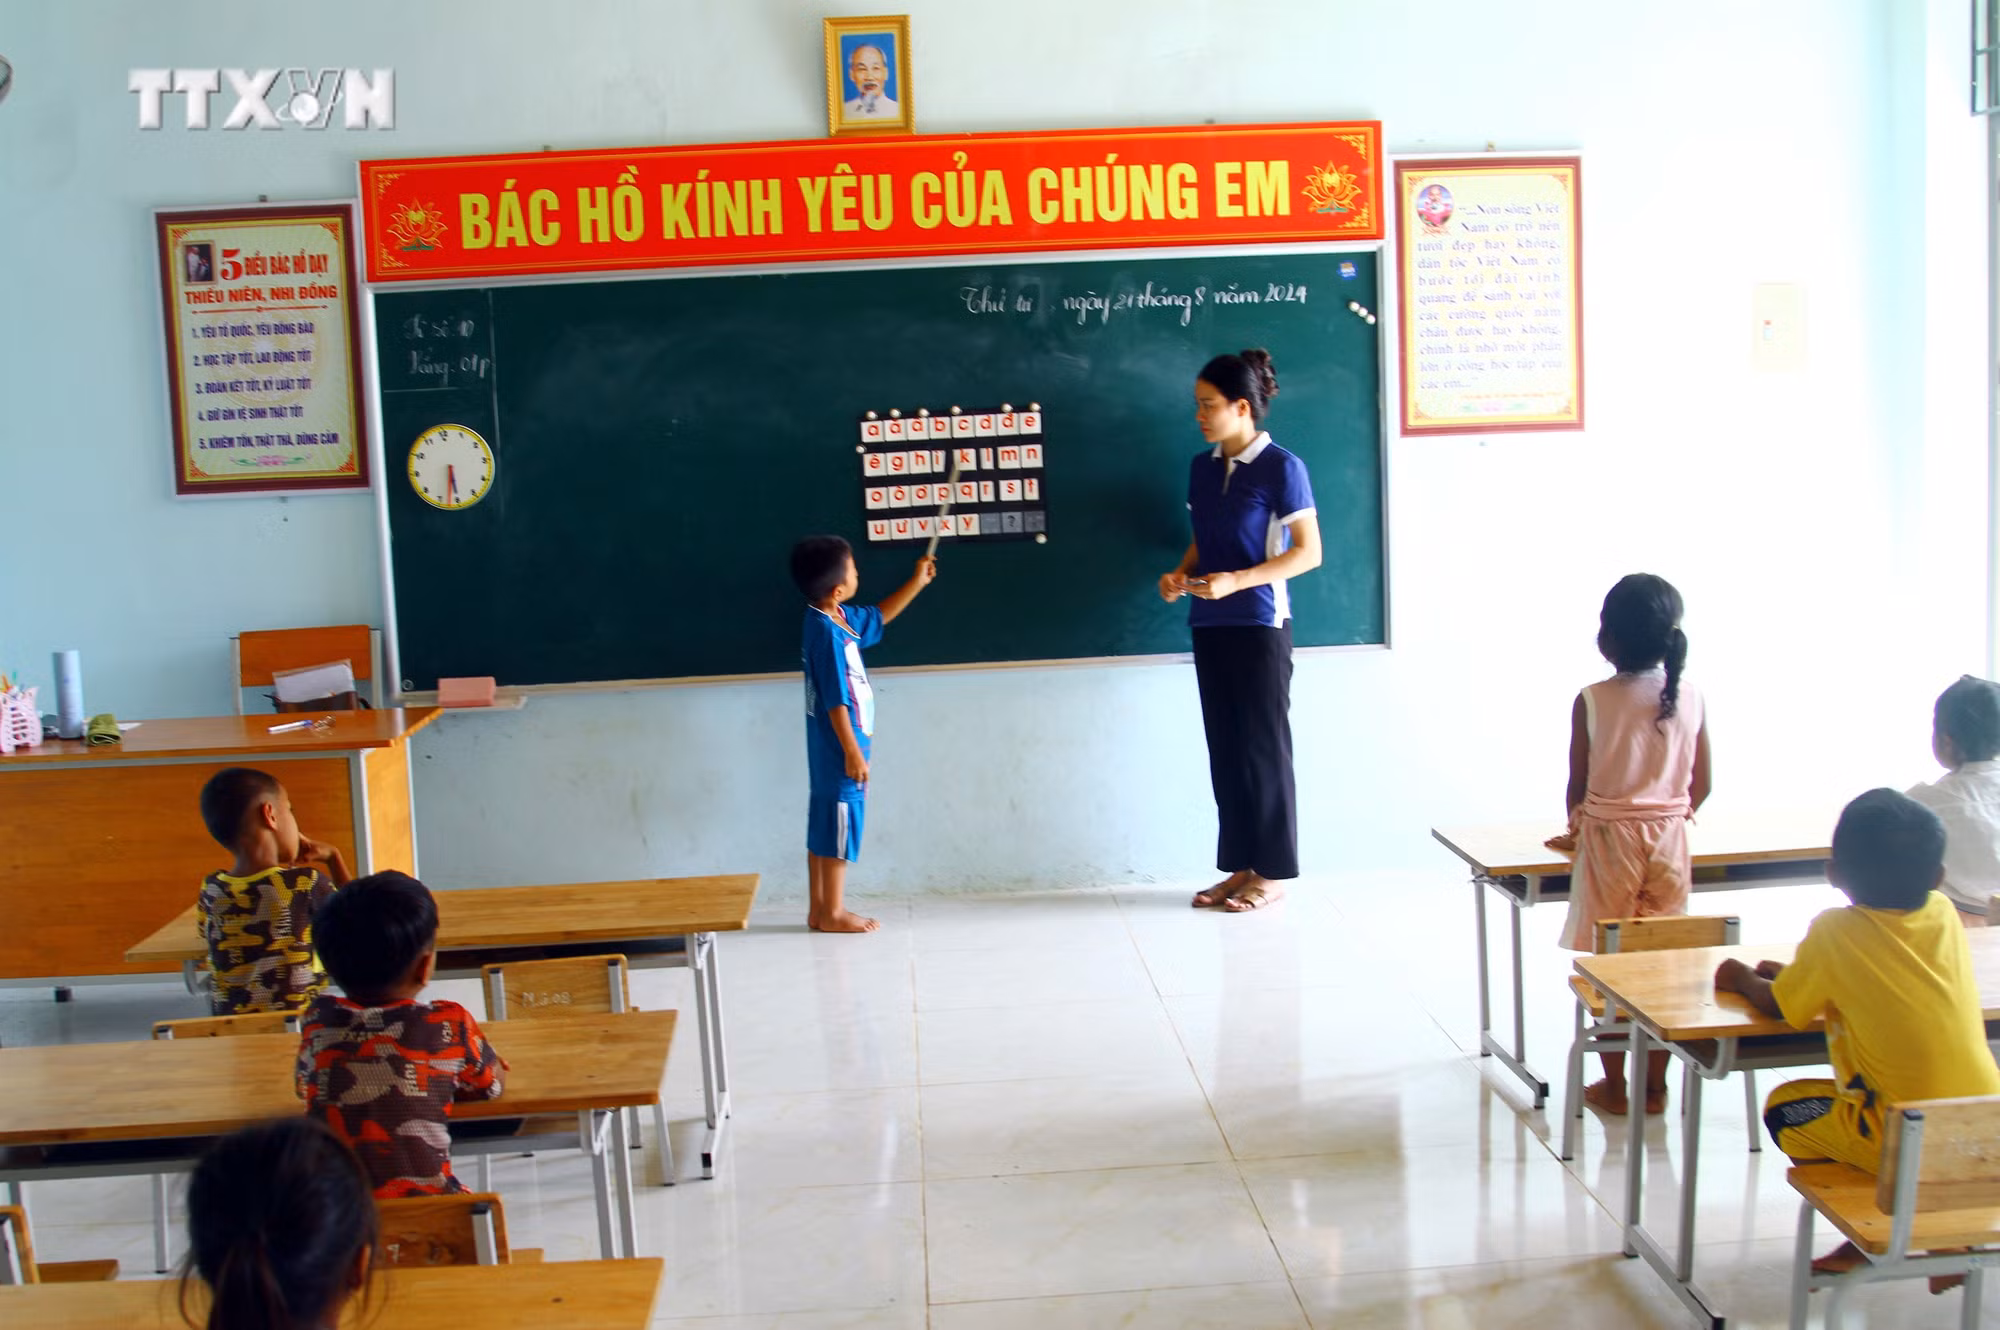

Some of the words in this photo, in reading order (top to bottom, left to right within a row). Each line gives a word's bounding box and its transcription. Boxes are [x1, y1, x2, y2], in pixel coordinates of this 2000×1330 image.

[459, 179, 561, 249] BÁC
[578, 165, 644, 243] HỒ
[661, 169, 783, 239] KÍNH
[797, 163, 894, 232] YÊU
[910, 151, 1013, 231] CỦA
[1027, 154, 1199, 224] CHÚNG
[1215, 160, 1291, 218] EM
[220, 248, 243, 280] 5
[244, 250, 267, 276] ĐIỀU
[269, 251, 290, 274] BÁC
[292, 248, 307, 273] HỒ
[308, 253, 329, 277] DẠY
[1063, 290, 1110, 325] ngày
[1137, 280, 1191, 326] tháng
[1195, 286, 1206, 306] 8
[1213, 282, 1260, 304] năm
[1264, 282, 1308, 304] 2024
[868, 424, 880, 436] a
[934, 416, 946, 432] b
[958, 418, 970, 431] c
[1002, 412, 1014, 428] đ
[1025, 415, 1036, 428] e
[892, 456, 904, 471] g
[914, 452, 926, 466] h
[960, 448, 970, 464] k
[1000, 448, 1018, 462] m
[1026, 447, 1038, 460] n
[871, 490, 883, 502] o
[938, 486, 950, 501] p
[960, 483, 973, 498] q
[1006, 482, 1016, 494] s
[874, 523, 885, 535] u
[918, 520, 929, 531] v
[962, 516, 974, 530] y
